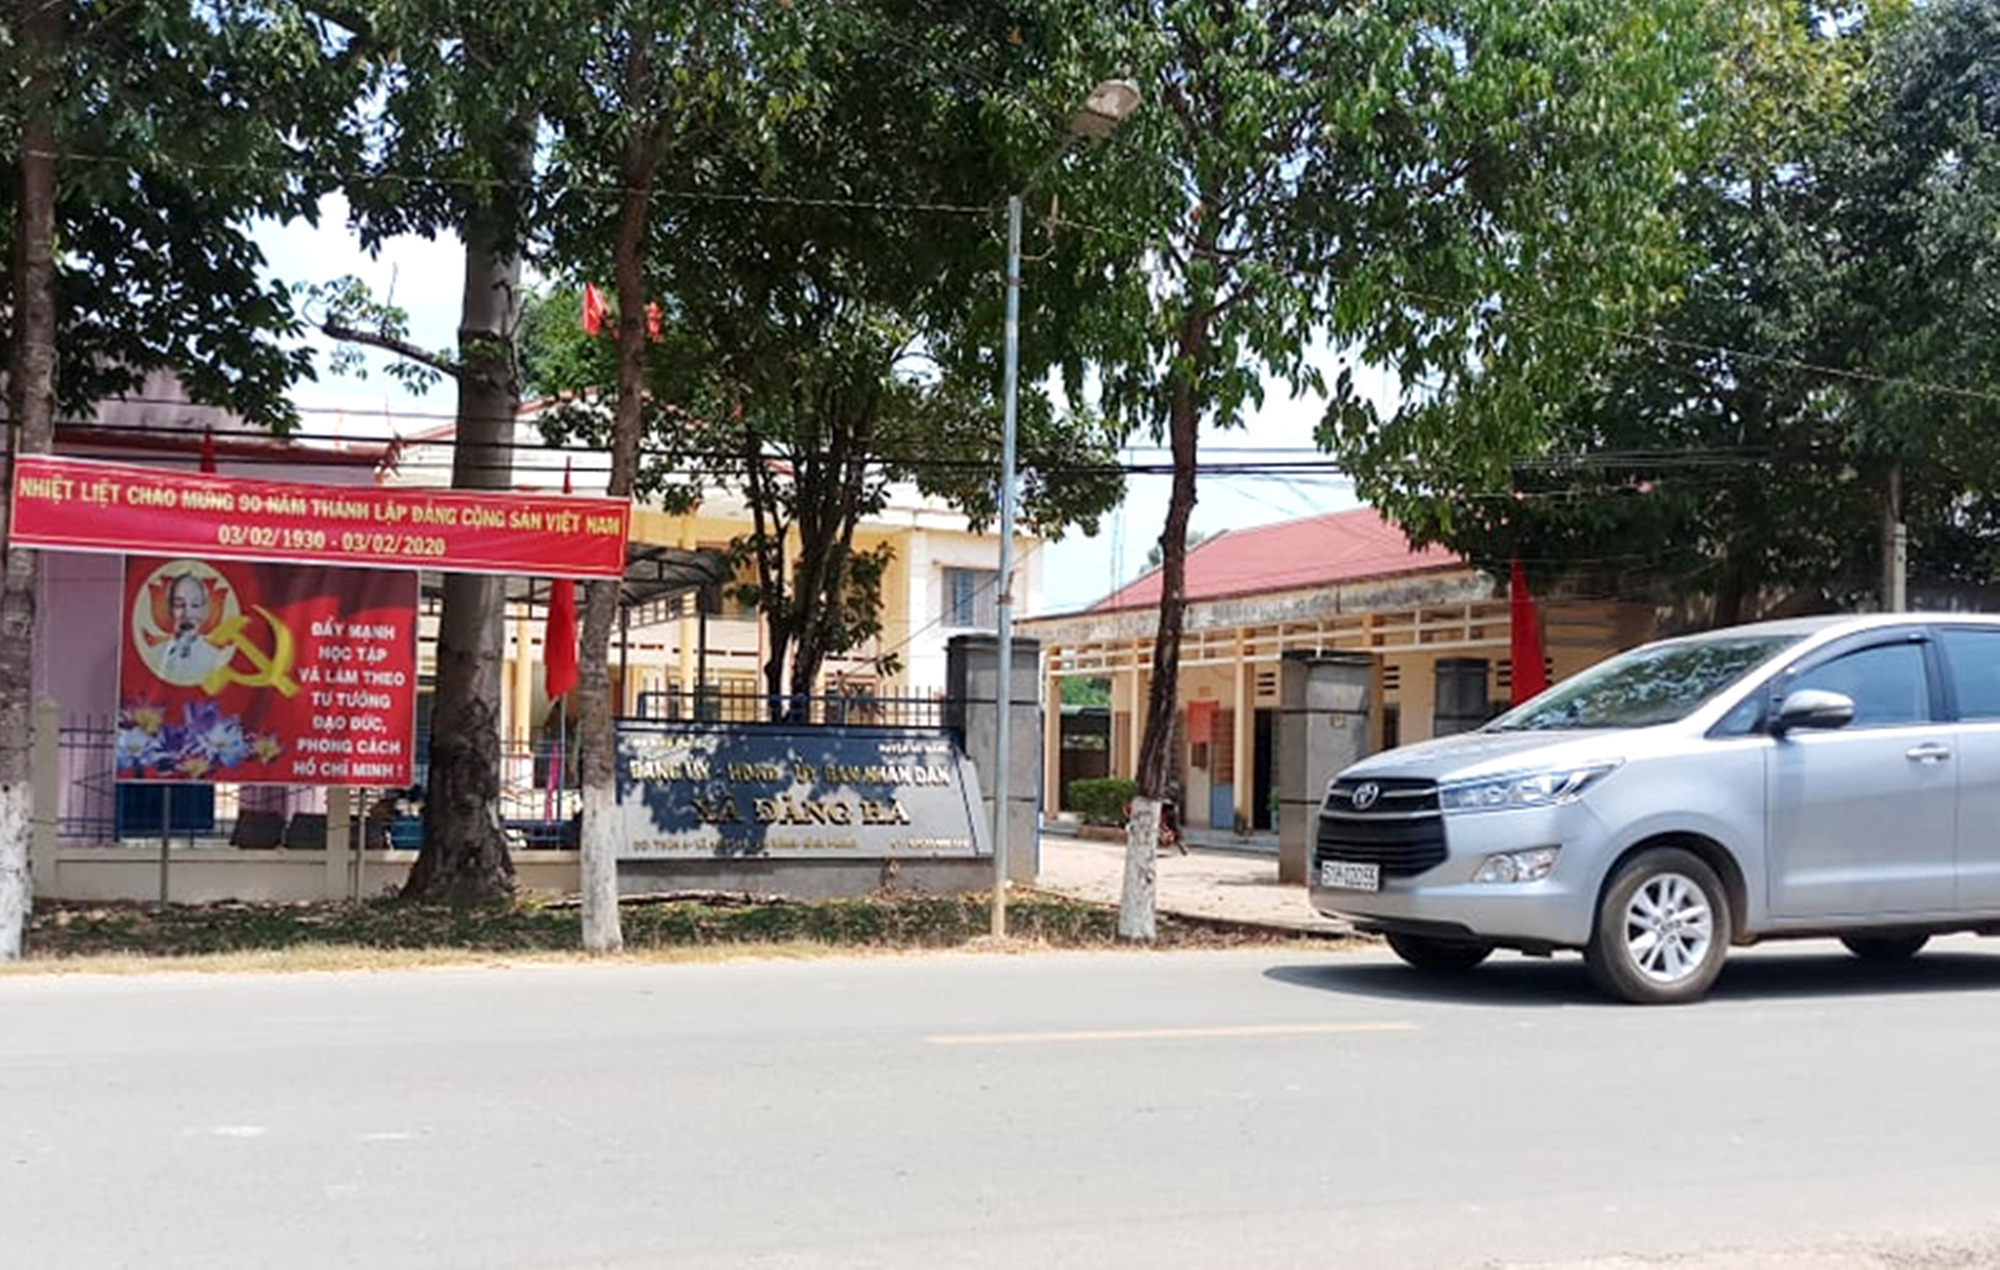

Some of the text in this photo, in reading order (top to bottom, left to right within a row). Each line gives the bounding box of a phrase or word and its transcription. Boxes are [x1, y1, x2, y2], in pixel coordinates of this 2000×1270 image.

[19, 473, 620, 535] NHIỆT LIỆT CHÀO MỪNG 90 NĂM THÀNH LẬP ĐẢNG CỘNG SẢN VIỆT NAM
[218, 524, 325, 549] 03/02/1930
[342, 531, 446, 556] 03/02/2020
[349, 625, 395, 643] MẠNH
[319, 645, 387, 666] HỌC TẬP
[363, 671, 405, 686] THEO
[336, 690, 391, 709] TƯỞNG
[313, 715, 346, 734] ĐẠO
[297, 737, 401, 755] PHONG CÁCH
[293, 757, 316, 776] HỒ
[320, 760, 349, 775] CHÍ
[352, 763, 393, 777] MINH
